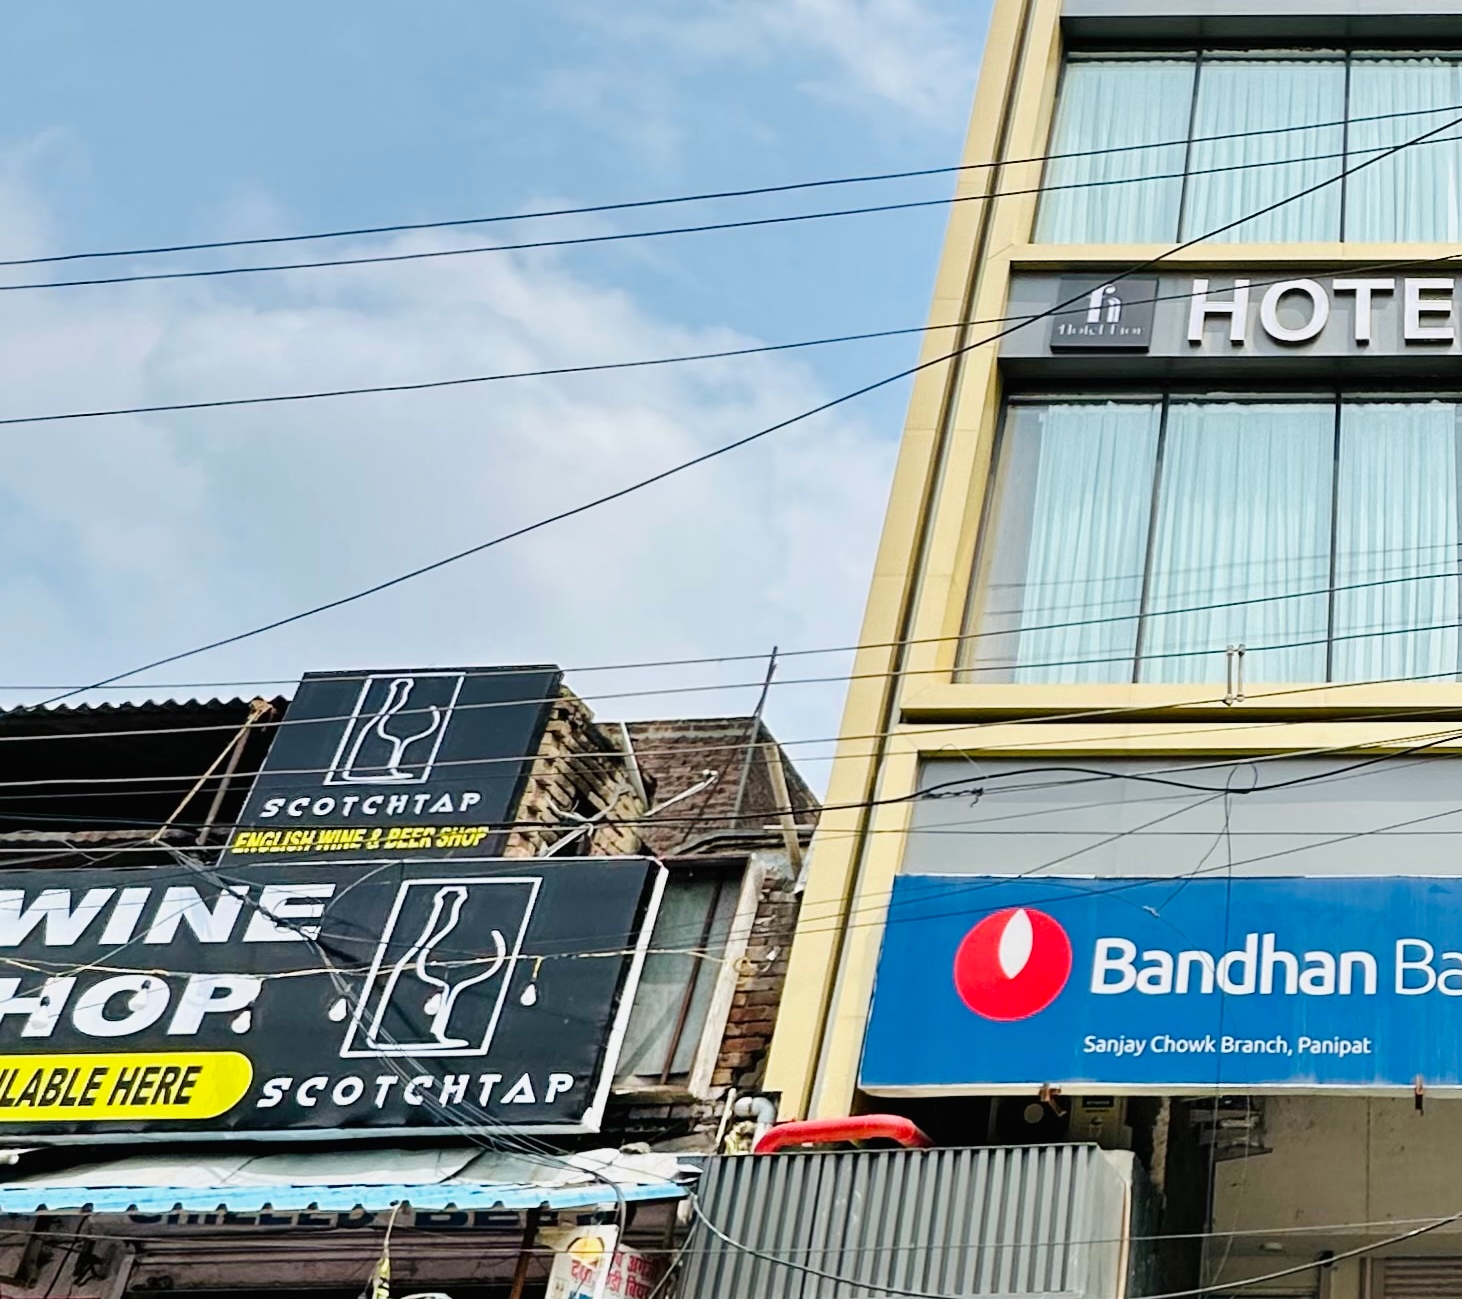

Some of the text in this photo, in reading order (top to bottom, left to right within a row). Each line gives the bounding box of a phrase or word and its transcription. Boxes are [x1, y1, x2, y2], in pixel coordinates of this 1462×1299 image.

[259, 791, 482, 818] SCOTCHTAP
[231, 826, 490, 854] ENGLISH WINE & BEER SHOP
[0, 884, 336, 946] WINE
[1090, 932, 1377, 996] Bandhan
[1083, 1034, 1372, 1057] Sanjay Chowk Branch, Panipat
[107, 1065, 204, 1106] HERE
[256, 1072, 575, 1109] SCOTCHTAP
